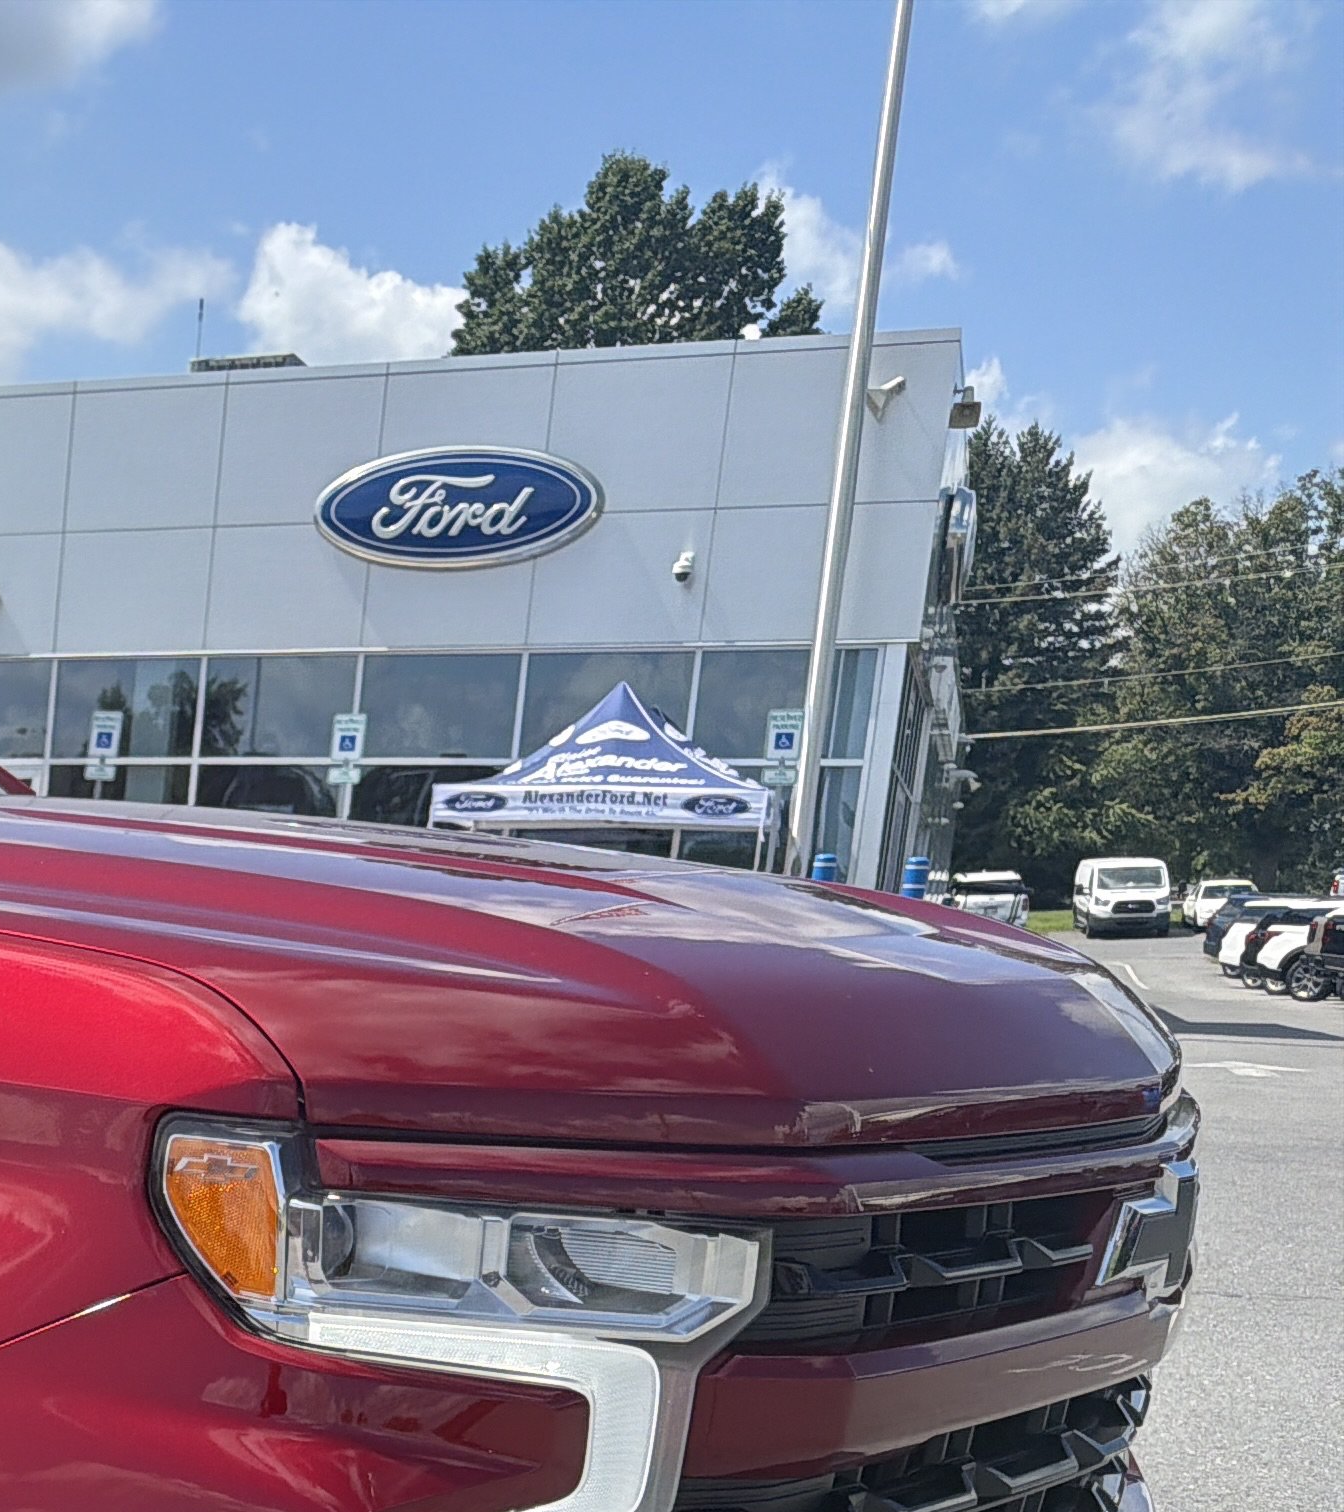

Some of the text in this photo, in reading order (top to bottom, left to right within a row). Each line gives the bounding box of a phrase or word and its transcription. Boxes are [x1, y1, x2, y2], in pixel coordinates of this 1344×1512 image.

[371, 474, 535, 540] Ford
[455, 794, 495, 809] Ford
[522, 790, 668, 808] AlexanderFord.Net
[695, 798, 737, 813] Ford
